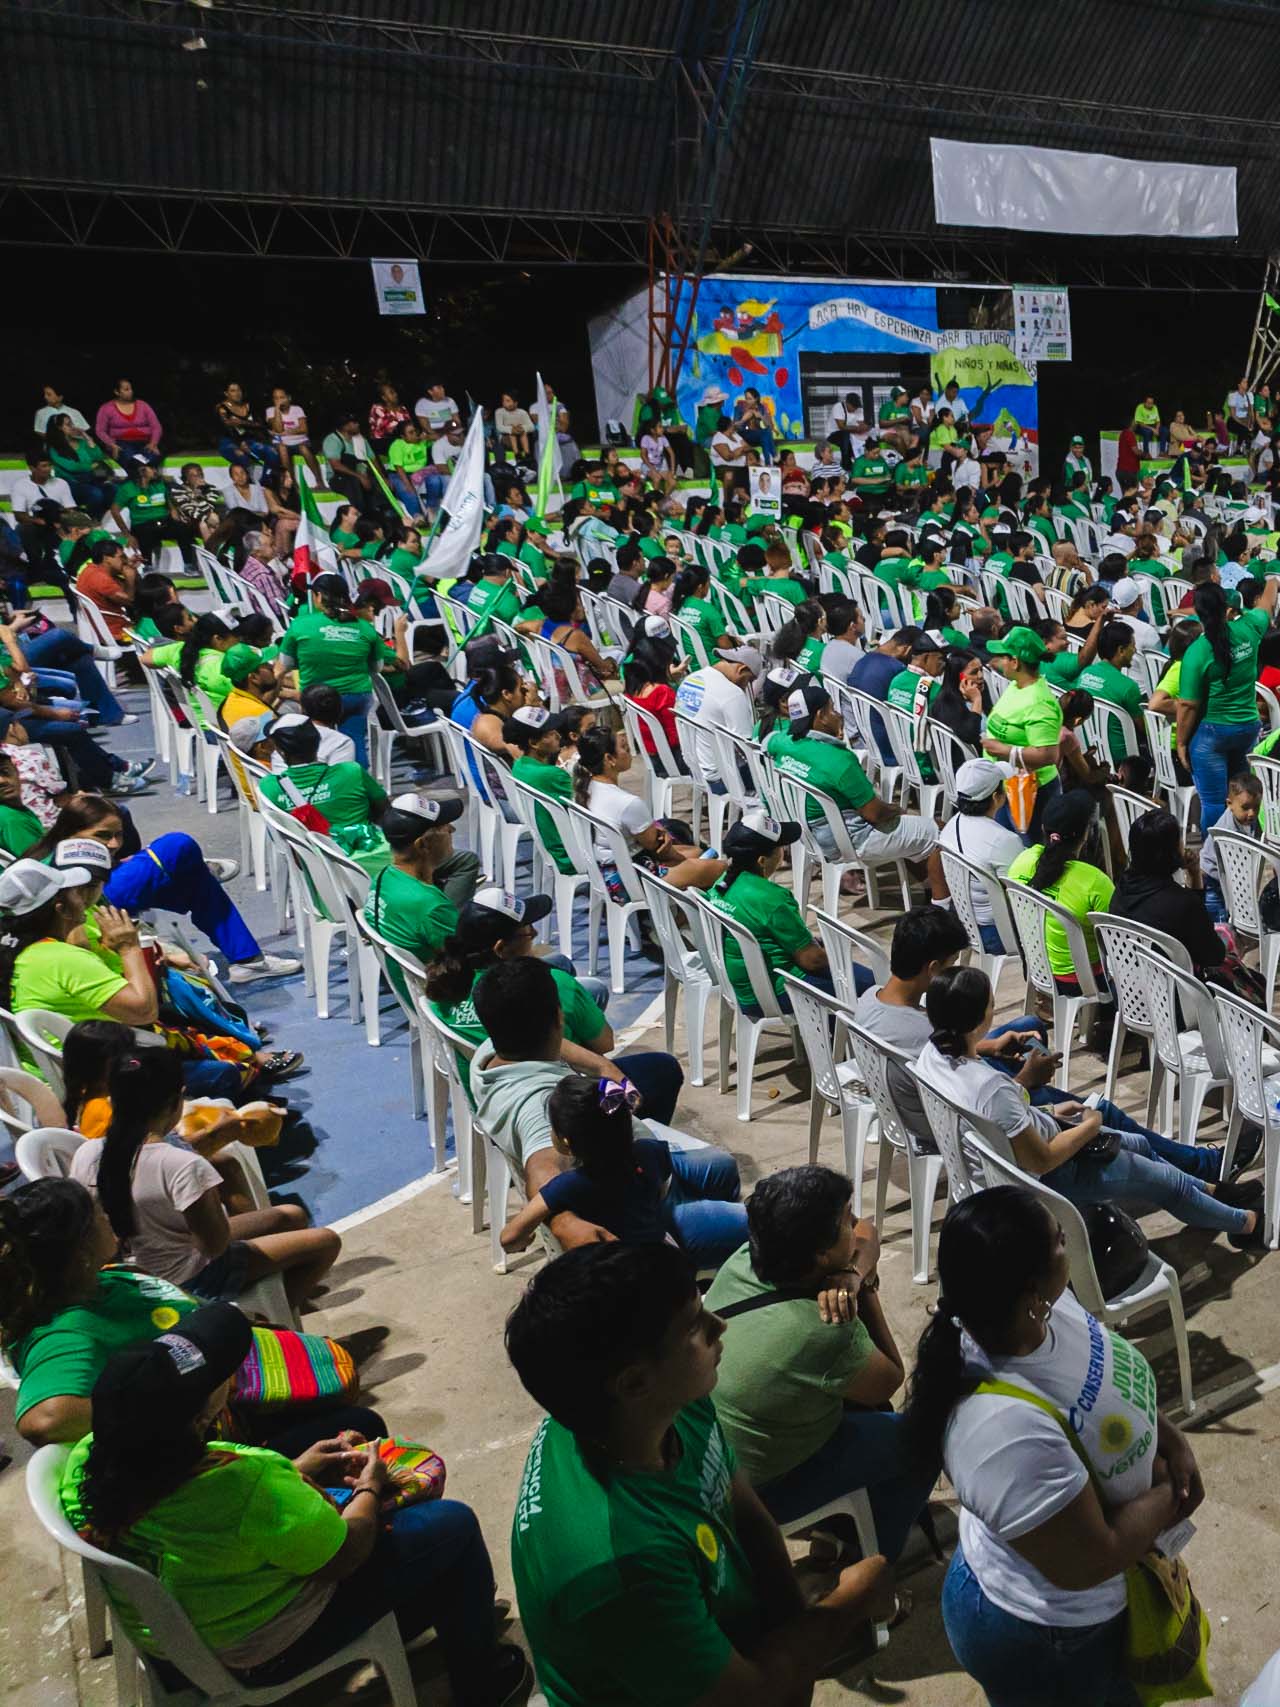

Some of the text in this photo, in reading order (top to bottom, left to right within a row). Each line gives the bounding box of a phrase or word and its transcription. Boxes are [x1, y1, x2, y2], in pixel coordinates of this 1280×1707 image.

[847, 302, 868, 319] HAY
[874, 312, 932, 343] ESPERANZA
[937, 331, 960, 351] PARA
[954, 357, 984, 370] NIÑOS
